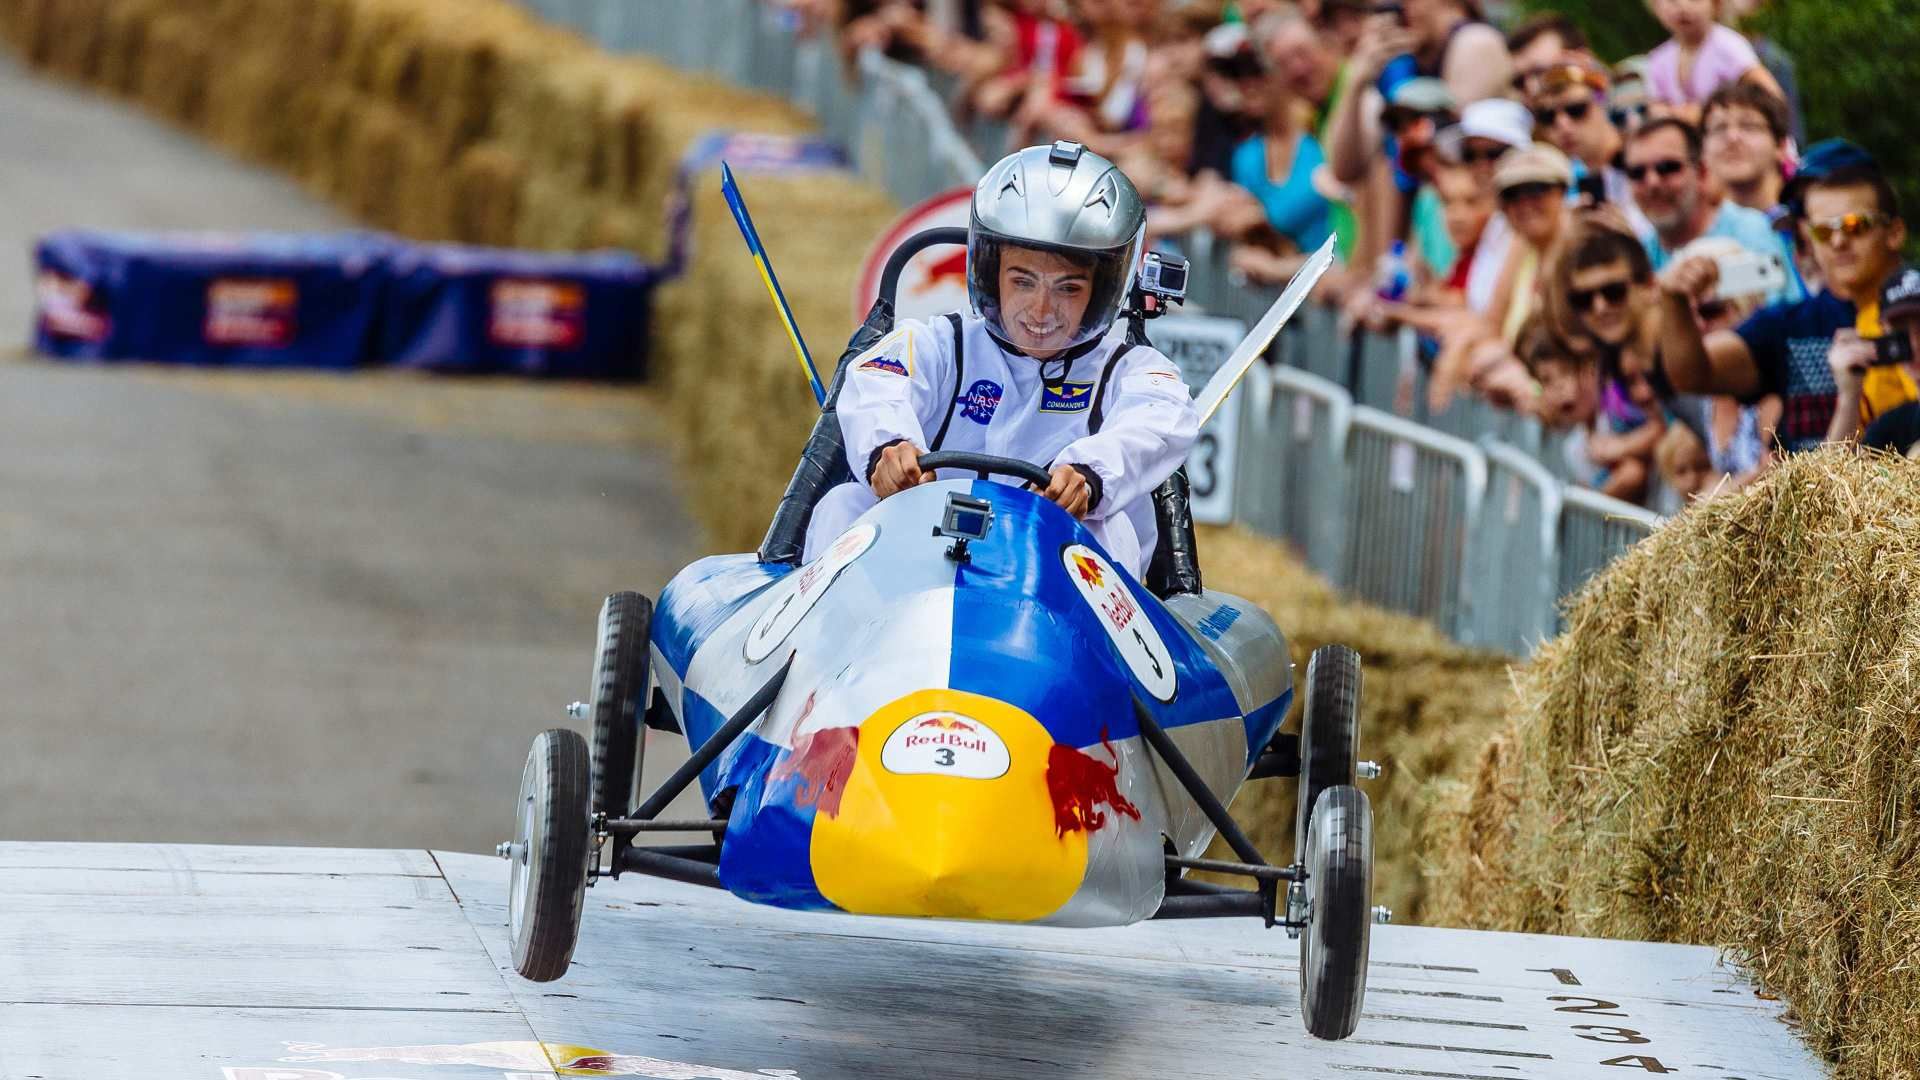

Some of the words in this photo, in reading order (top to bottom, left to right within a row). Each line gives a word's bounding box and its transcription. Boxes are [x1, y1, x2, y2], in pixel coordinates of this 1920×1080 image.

[1046, 401, 1085, 409] COMMANDER
[905, 733, 945, 748] Red
[948, 734, 986, 753] Bull
[934, 748, 955, 766] 3
[1546, 996, 1629, 1017] 2
[1570, 1025, 1652, 1044] 3
[1600, 1055, 1679, 1074] 4
